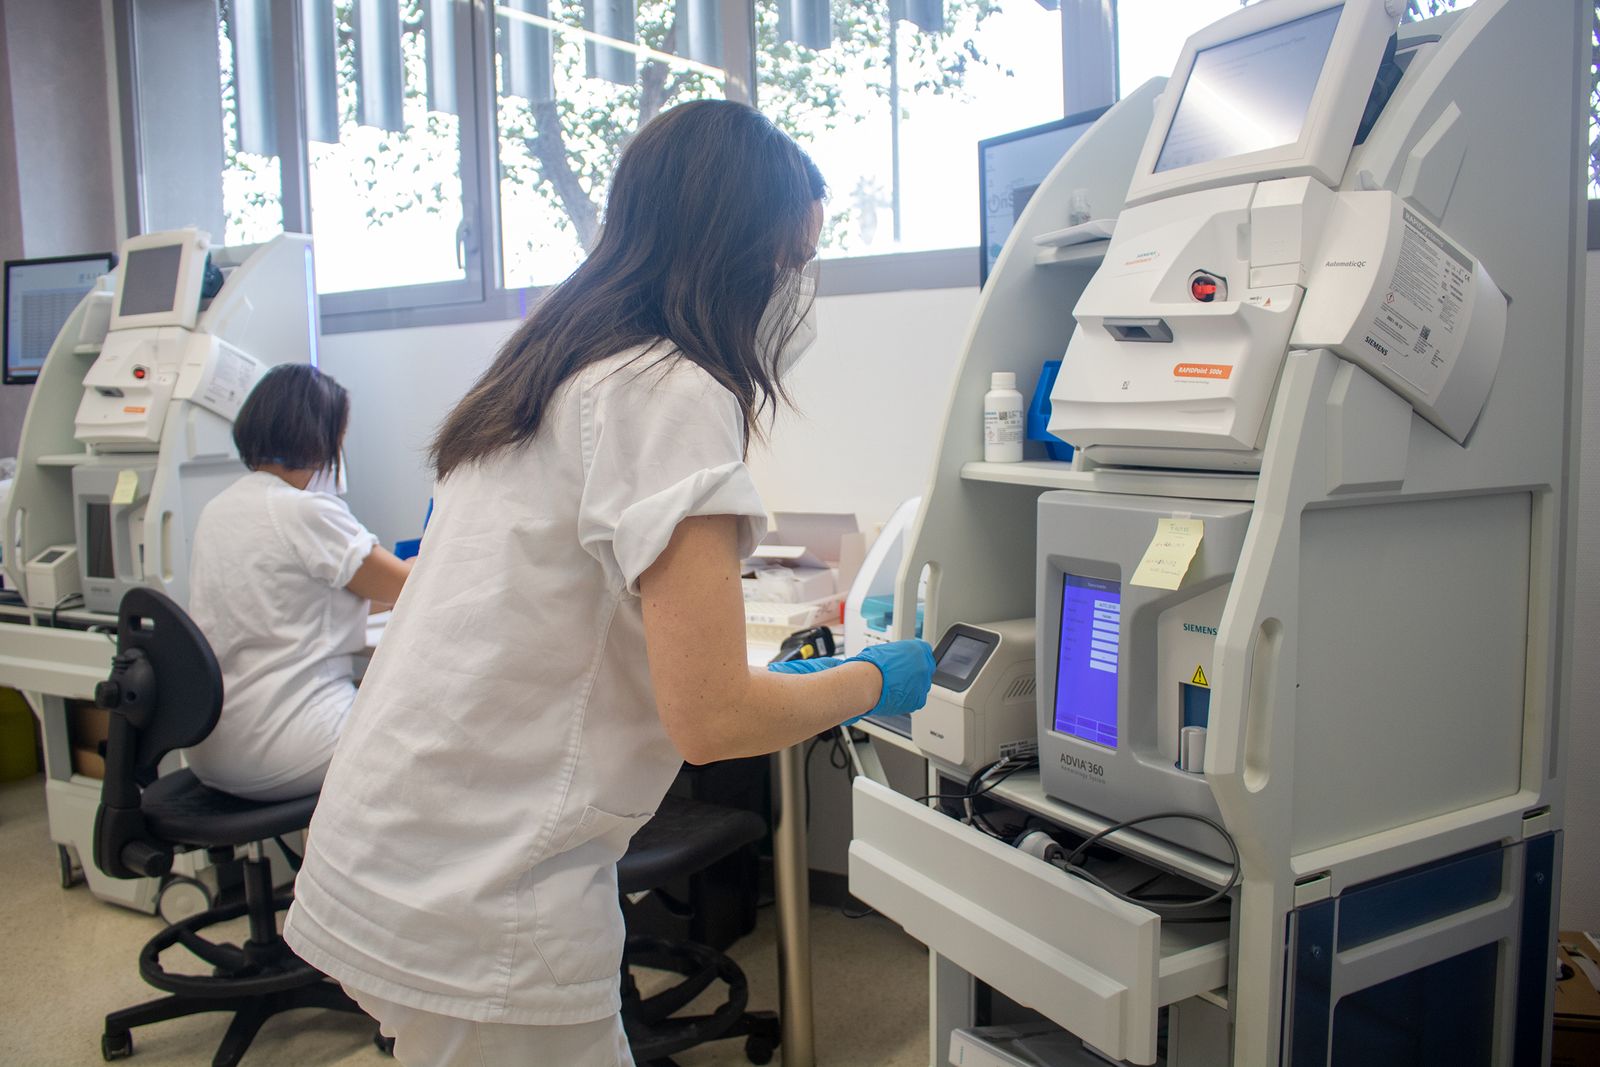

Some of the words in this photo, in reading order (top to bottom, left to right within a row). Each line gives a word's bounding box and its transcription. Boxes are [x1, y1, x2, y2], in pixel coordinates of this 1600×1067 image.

[1325, 259, 1367, 268] AutomaticQC
[1364, 335, 1389, 356] SIEMENS
[1178, 366, 1208, 375] RAPIDPoint
[1183, 623, 1218, 636] SIEMENS
[1088, 761, 1104, 777] 360
